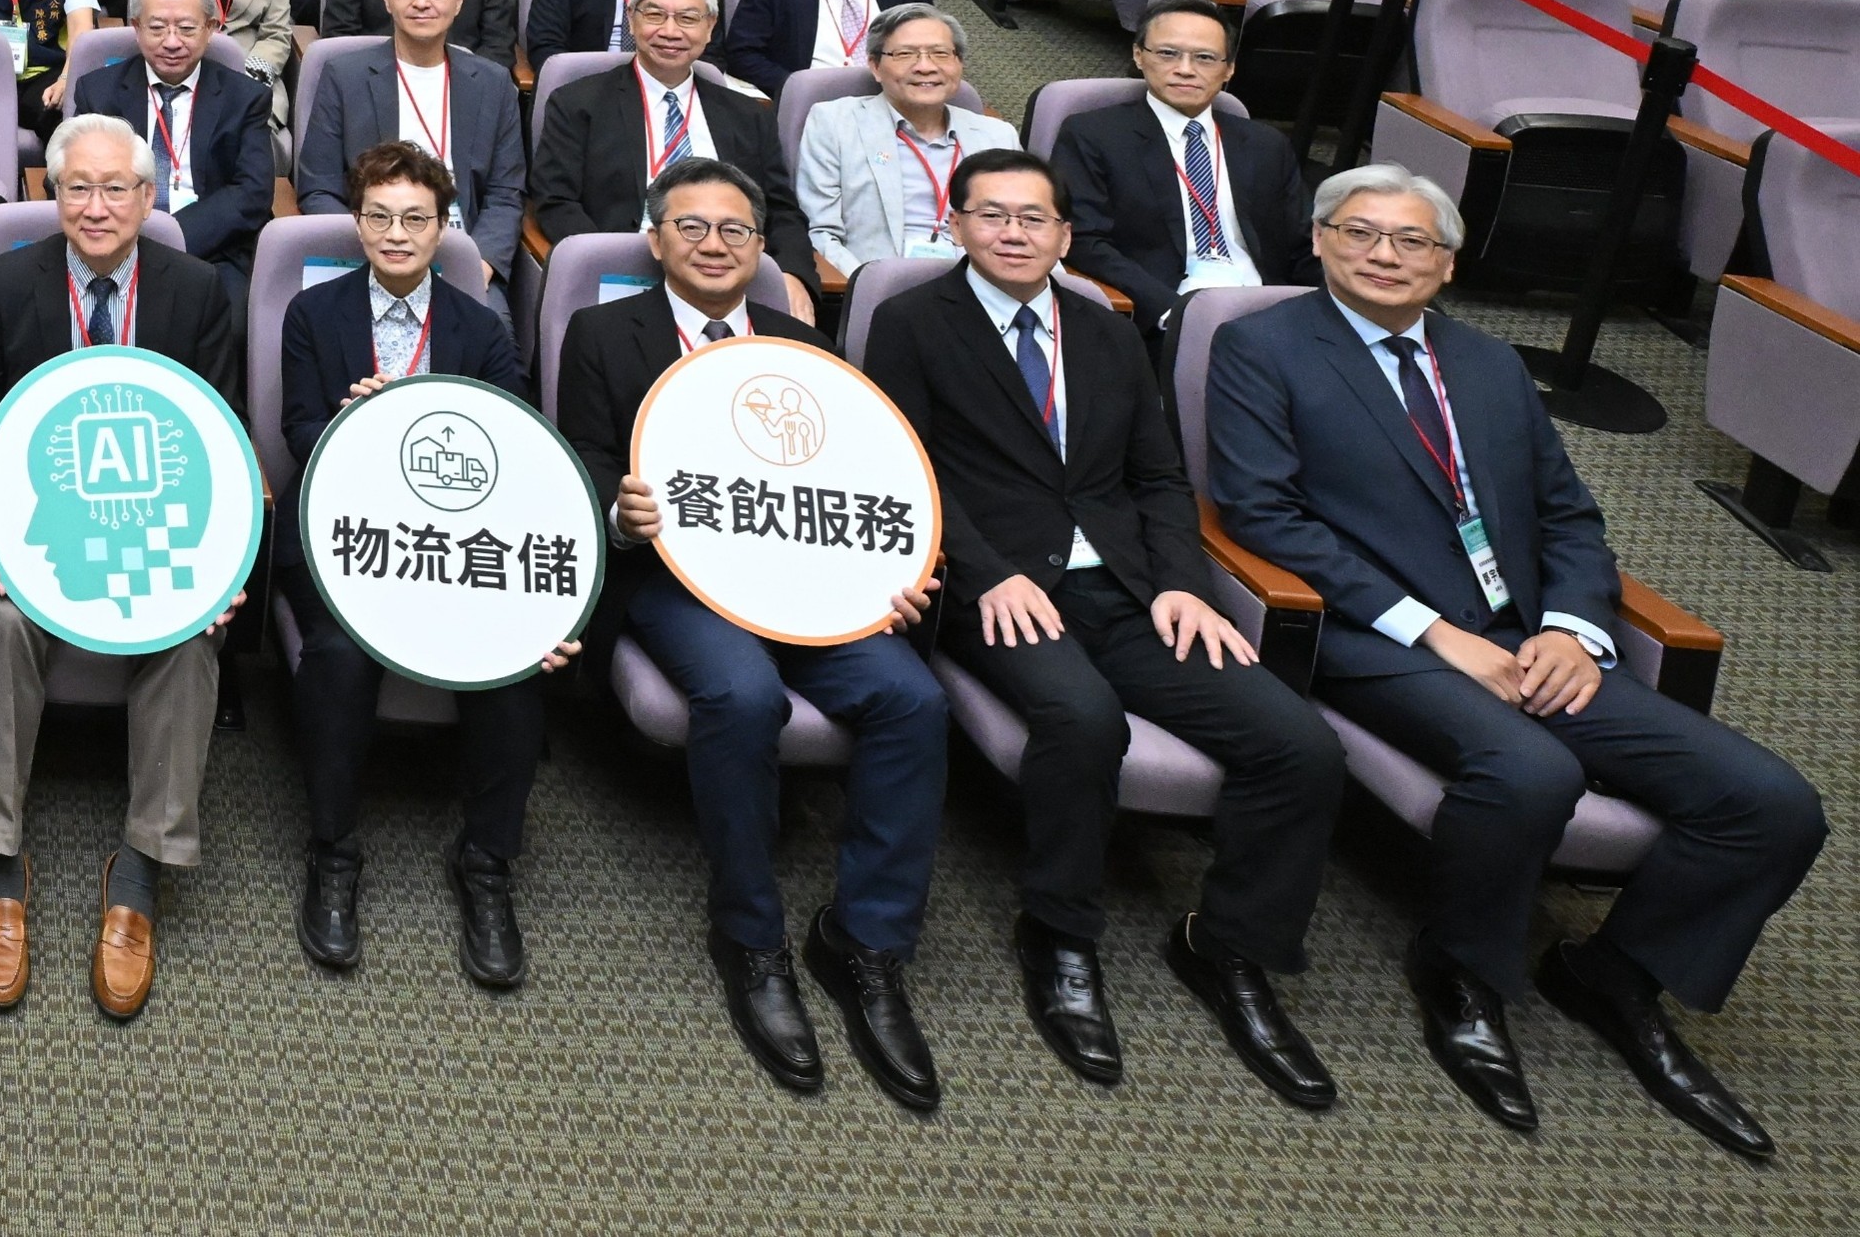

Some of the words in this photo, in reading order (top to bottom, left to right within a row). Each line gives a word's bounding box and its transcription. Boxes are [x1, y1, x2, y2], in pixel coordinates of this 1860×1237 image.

[87, 425, 149, 483] AI
[665, 470, 917, 557] 餐飲服務
[331, 514, 579, 598] 物流倉儲
